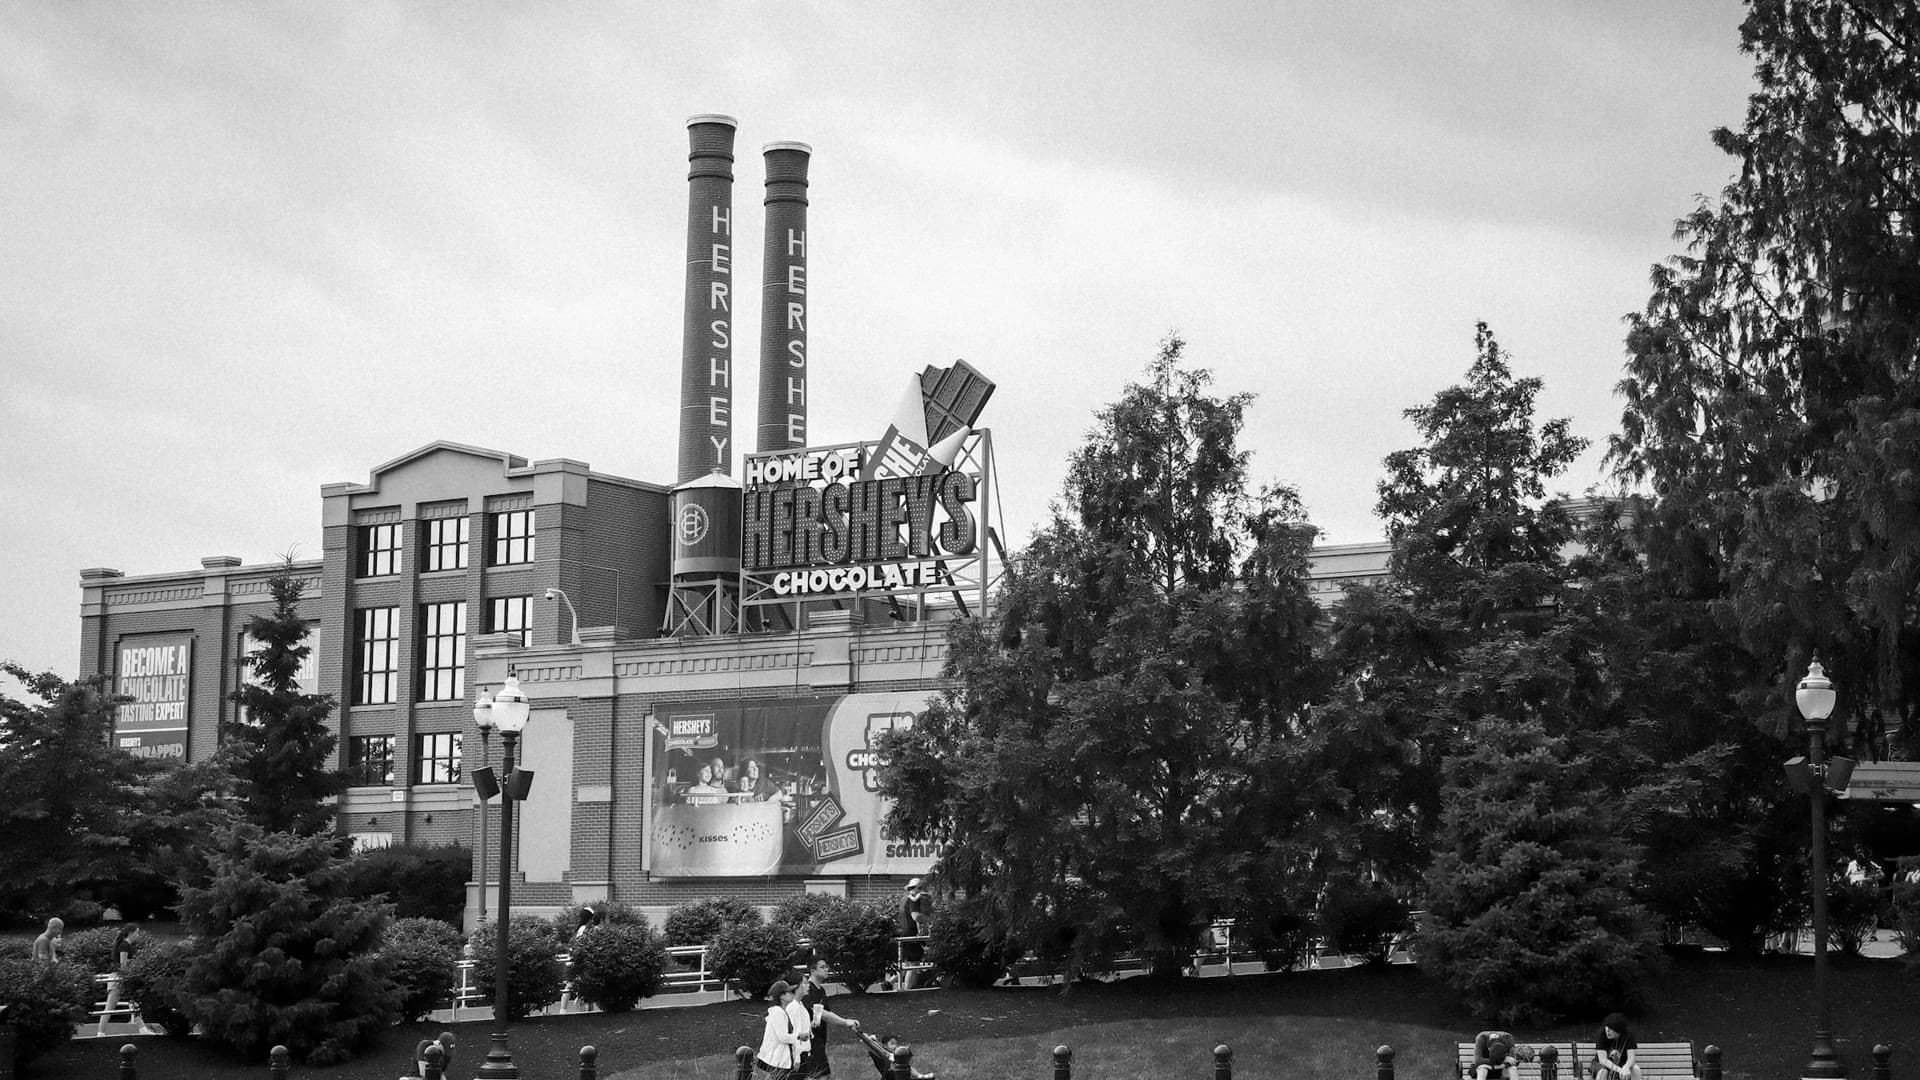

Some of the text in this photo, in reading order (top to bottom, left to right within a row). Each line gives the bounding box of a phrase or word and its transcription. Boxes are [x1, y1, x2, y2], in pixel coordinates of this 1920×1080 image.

[711, 205, 730, 465] HERSHEY
[787, 228, 806, 461] HERSHE
[746, 453, 859, 485] HOME OF
[743, 471, 976, 569] HERSHEY'S
[774, 561, 939, 595] CHOCOLATE
[121, 645, 187, 677] BECOME A
[121, 675, 186, 702] CHOCOLATE
[120, 702, 185, 722] TASTING EXPERT
[673, 719, 711, 735] HERSHEY'S
